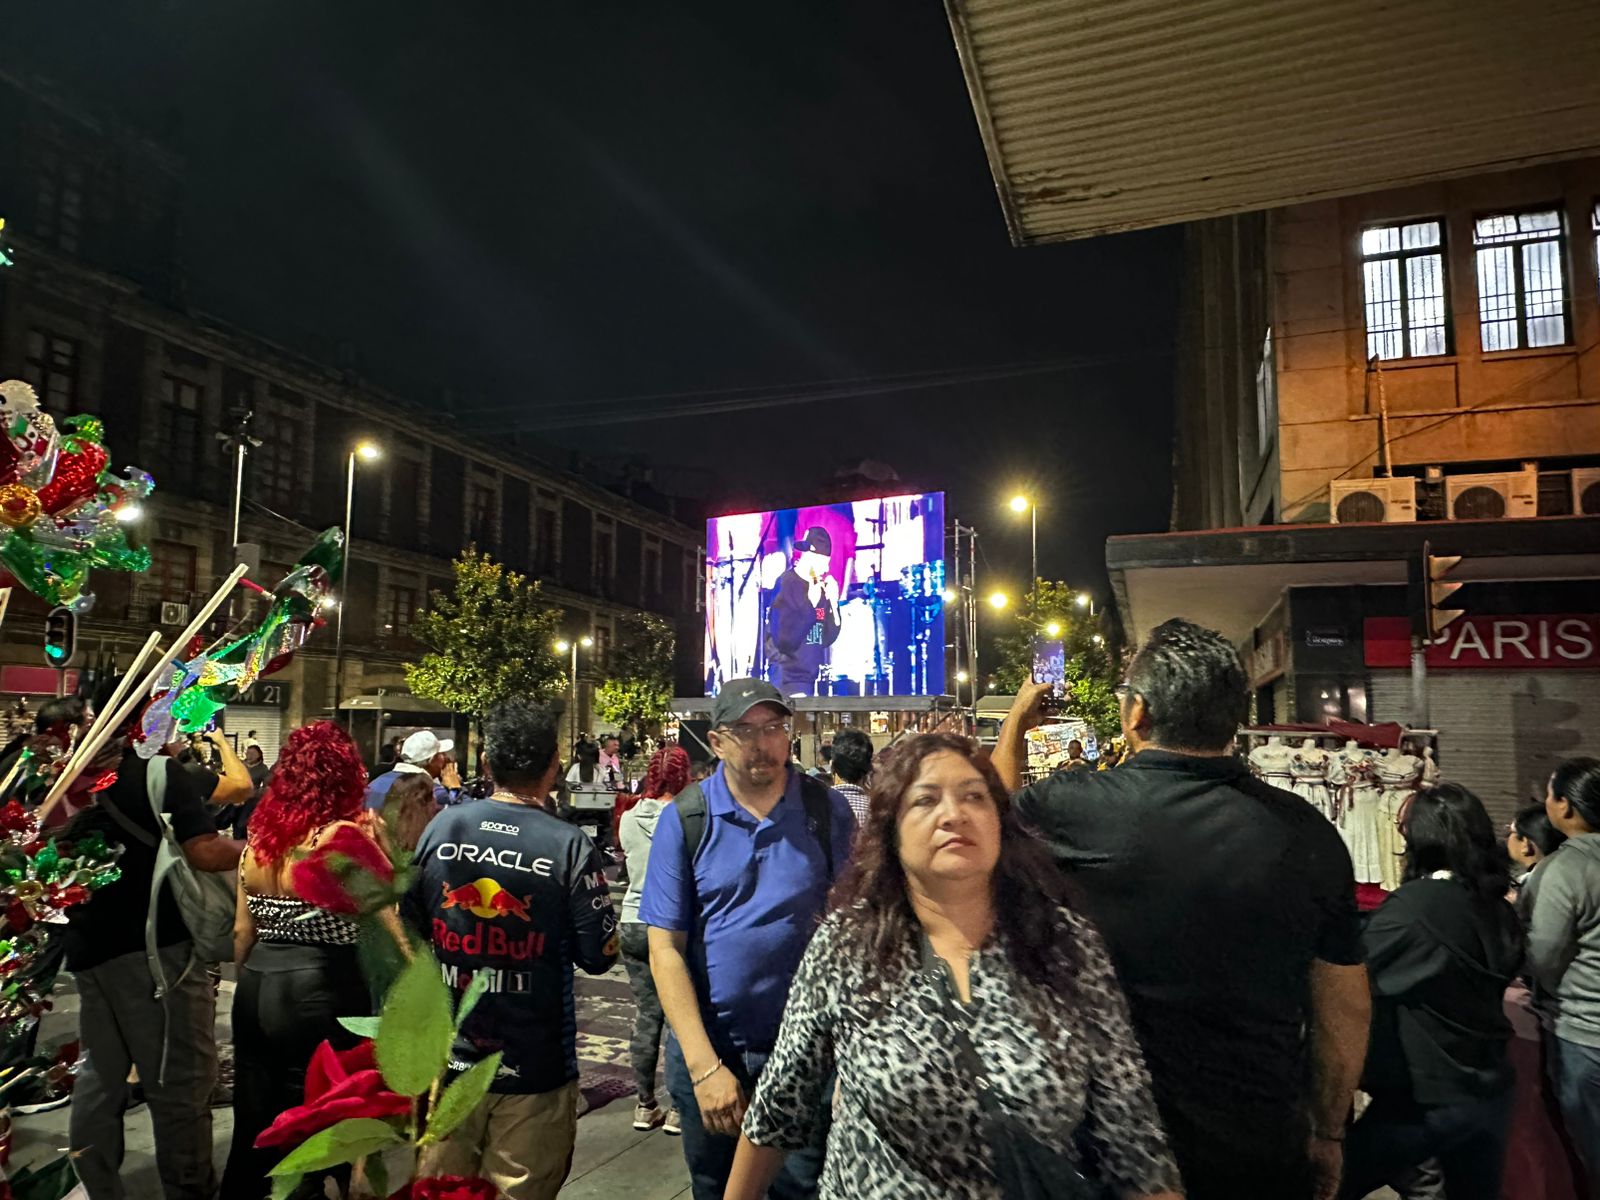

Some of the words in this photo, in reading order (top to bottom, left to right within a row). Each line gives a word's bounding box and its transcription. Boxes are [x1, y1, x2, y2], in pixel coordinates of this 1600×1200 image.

[480, 821, 520, 835] sparco
[436, 843, 554, 877] ORACLE
[432, 917, 484, 955] Red
[487, 926, 545, 960] Bull
